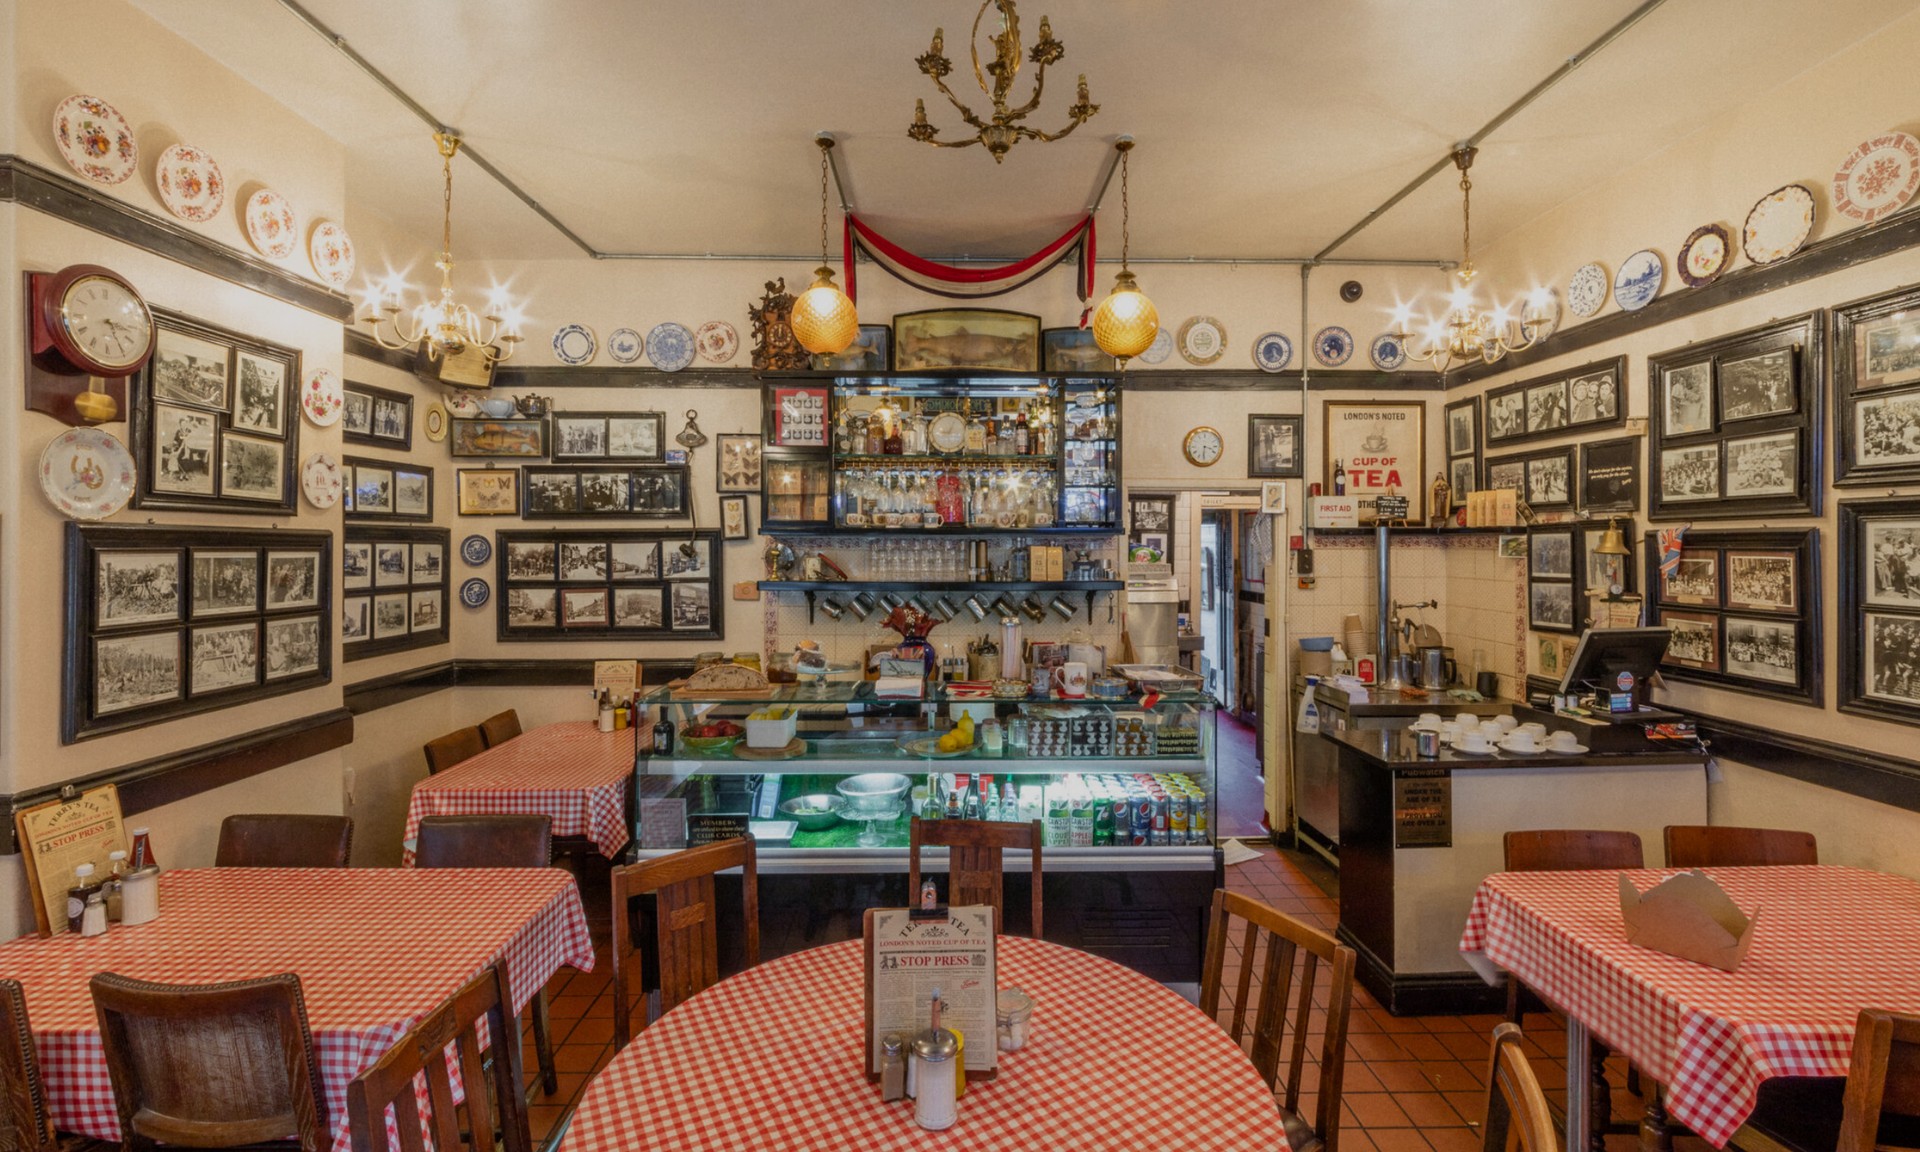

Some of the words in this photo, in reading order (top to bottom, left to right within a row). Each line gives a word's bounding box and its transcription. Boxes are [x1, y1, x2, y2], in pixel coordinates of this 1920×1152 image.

[1343, 412, 1380, 421] LONDON'S
[1382, 412, 1406, 420] NOTED
[1352, 457, 1378, 466] CUP
[1381, 457, 1397, 466] OF
[1347, 469, 1402, 488] TEA
[1357, 500, 1379, 509] OTHE
[48, 803, 81, 827] TERRY'S
[84, 801, 100, 813] TEA
[52, 834, 78, 848] STOP
[78, 824, 105, 840] PRESS
[950, 916, 970, 936] TEA
[900, 955, 931, 966] STOP
[934, 955, 970, 966] PRESS
